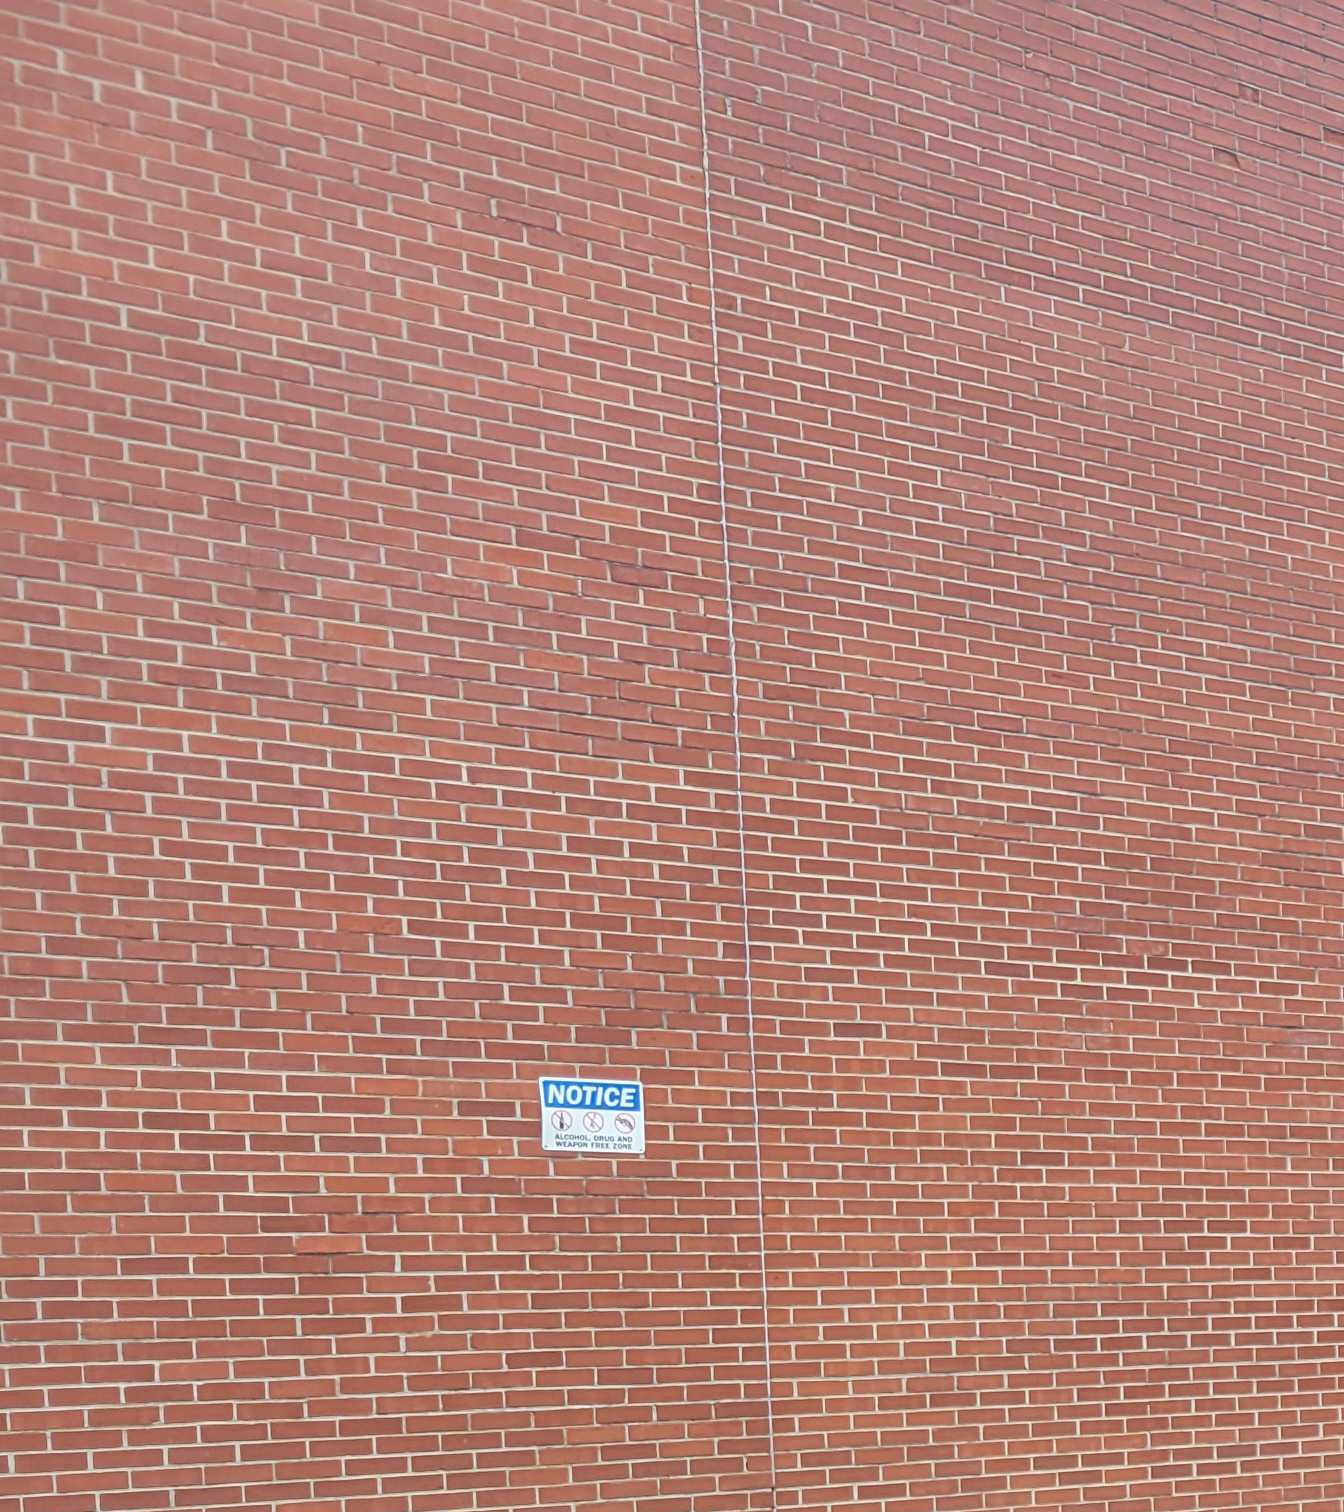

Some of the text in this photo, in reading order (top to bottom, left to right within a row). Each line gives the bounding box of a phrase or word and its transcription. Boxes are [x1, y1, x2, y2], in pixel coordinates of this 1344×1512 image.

[547, 1083, 637, 1108] NOTICE
[594, 1134, 615, 1143] DRUG
[617, 1135, 633, 1143] AND
[555, 1140, 633, 1151] WEAPON FREE ZONE
